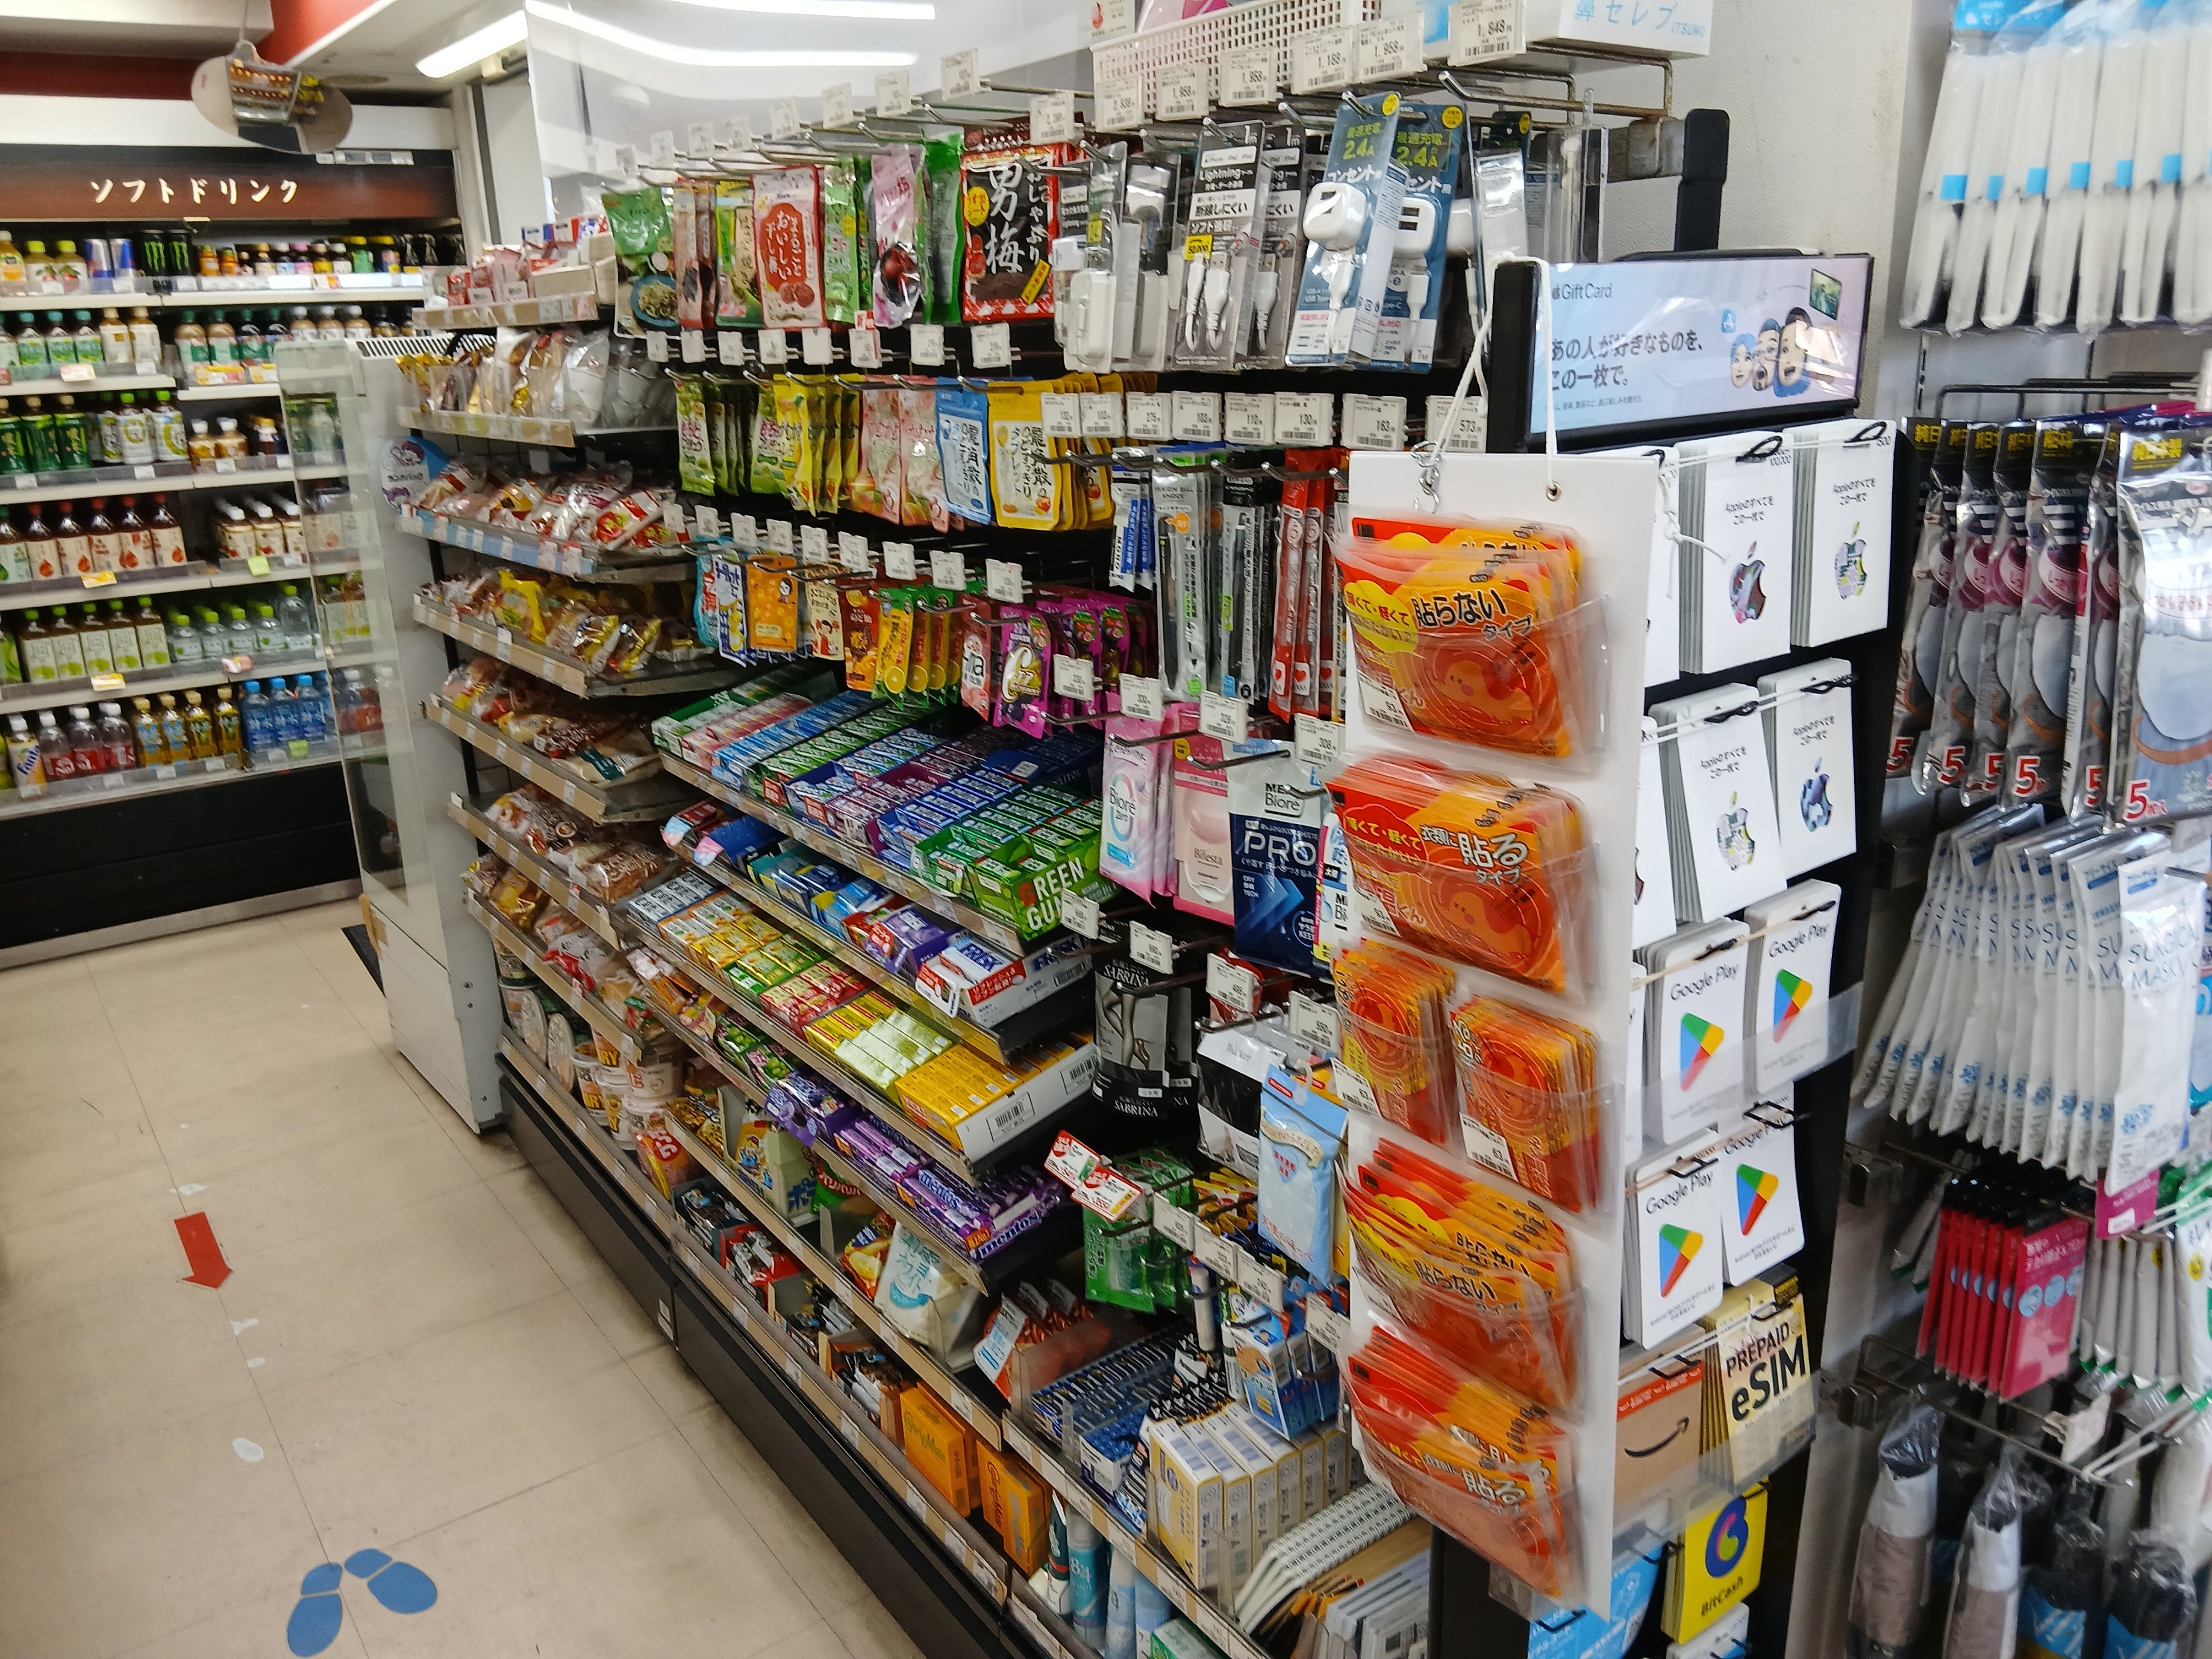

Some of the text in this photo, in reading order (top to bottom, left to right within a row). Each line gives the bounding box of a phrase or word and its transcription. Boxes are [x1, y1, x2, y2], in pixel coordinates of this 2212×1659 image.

[90, 178, 299, 205] ソフトドリンク
[1561, 283, 1613, 300] Gift Card
[1413, 588, 1507, 628] 貼らない
[1481, 614, 1534, 640] タイプ
[1110, 786, 1137, 816] Biore
[1264, 792, 1301, 811] Biore
[1243, 831, 1317, 866] PRO
[1019, 857, 1086, 907] GREEN
[1475, 865, 1522, 887] タイプ
[1769, 922, 1830, 958] Google Play
[1670, 964, 1740, 1001] Google Play
[1113, 1099, 1158, 1117] SABRINA
[918, 1169, 960, 1210] mentos
[1645, 1170, 1714, 1215] Google Play
[978, 1211, 1042, 1257] mentos
[1725, 1320, 1790, 1378] PREPAID
[1731, 1334, 1806, 1422] eSIM
